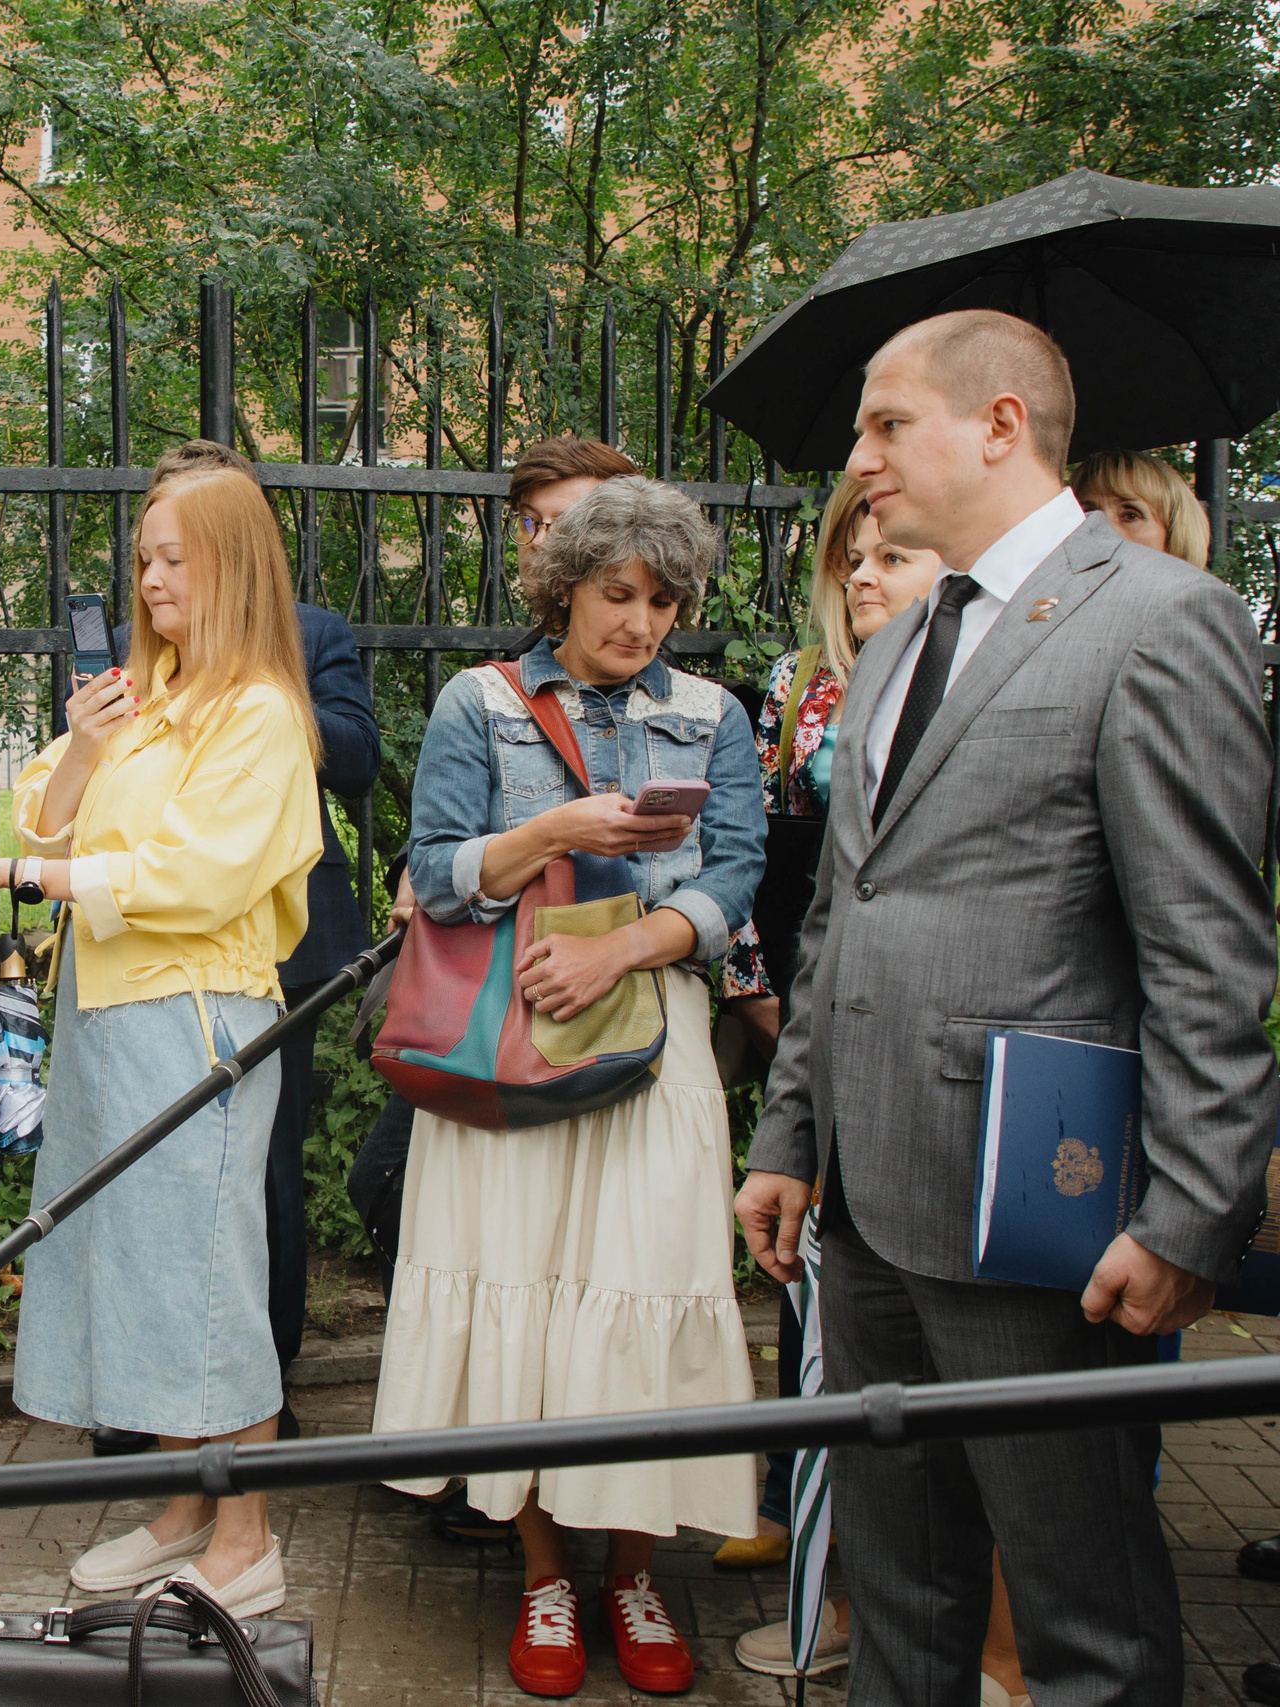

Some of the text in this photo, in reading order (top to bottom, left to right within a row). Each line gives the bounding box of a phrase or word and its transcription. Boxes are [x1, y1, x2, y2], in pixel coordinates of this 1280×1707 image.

[1114, 1113, 1134, 1239] ОСУДАРСТВЕННАЯ ДУМА
[1128, 1167, 1139, 1220] РАЛЬНОГО
